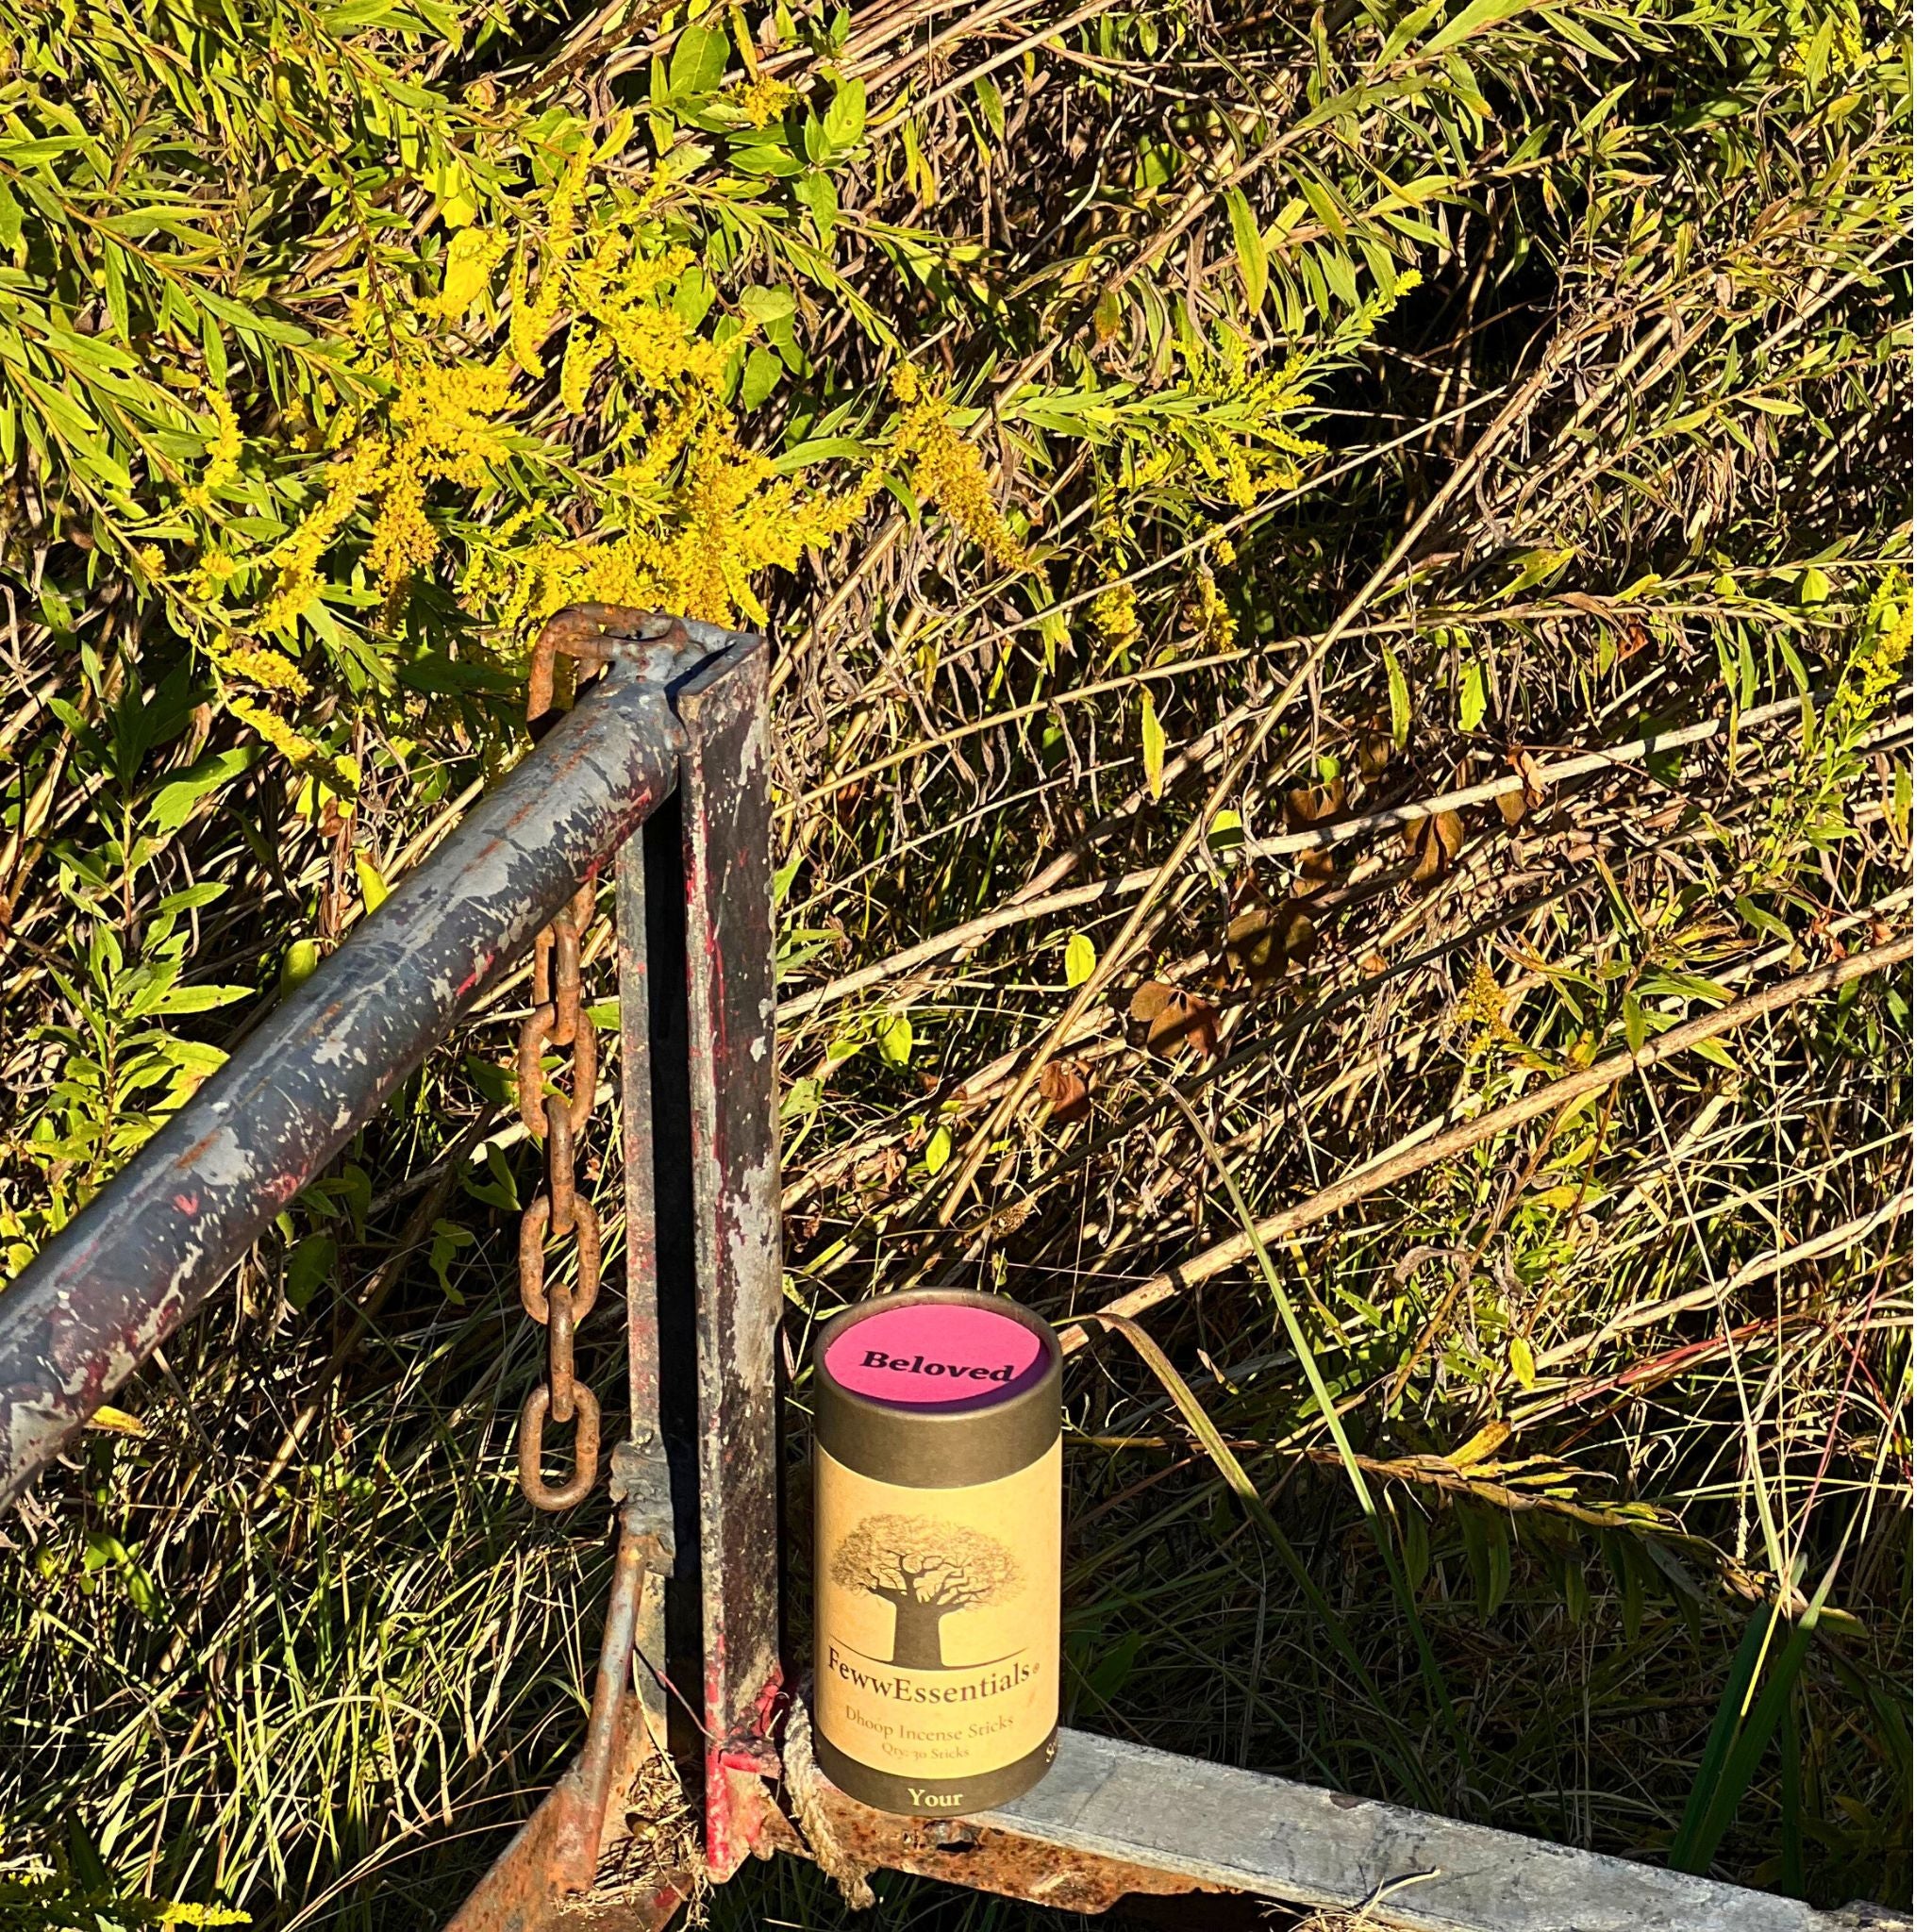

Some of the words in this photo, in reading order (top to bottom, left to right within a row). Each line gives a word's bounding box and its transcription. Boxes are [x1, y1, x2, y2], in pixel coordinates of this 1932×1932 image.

[859, 1350, 1016, 1383] Beloved
[845, 1705, 894, 1740] Dhoop
[898, 1724, 963, 1741] Incense
[968, 1715, 1014, 1739] Sticks
[930, 1746, 970, 1760] Sticks
[908, 1788, 964, 1807] Your
